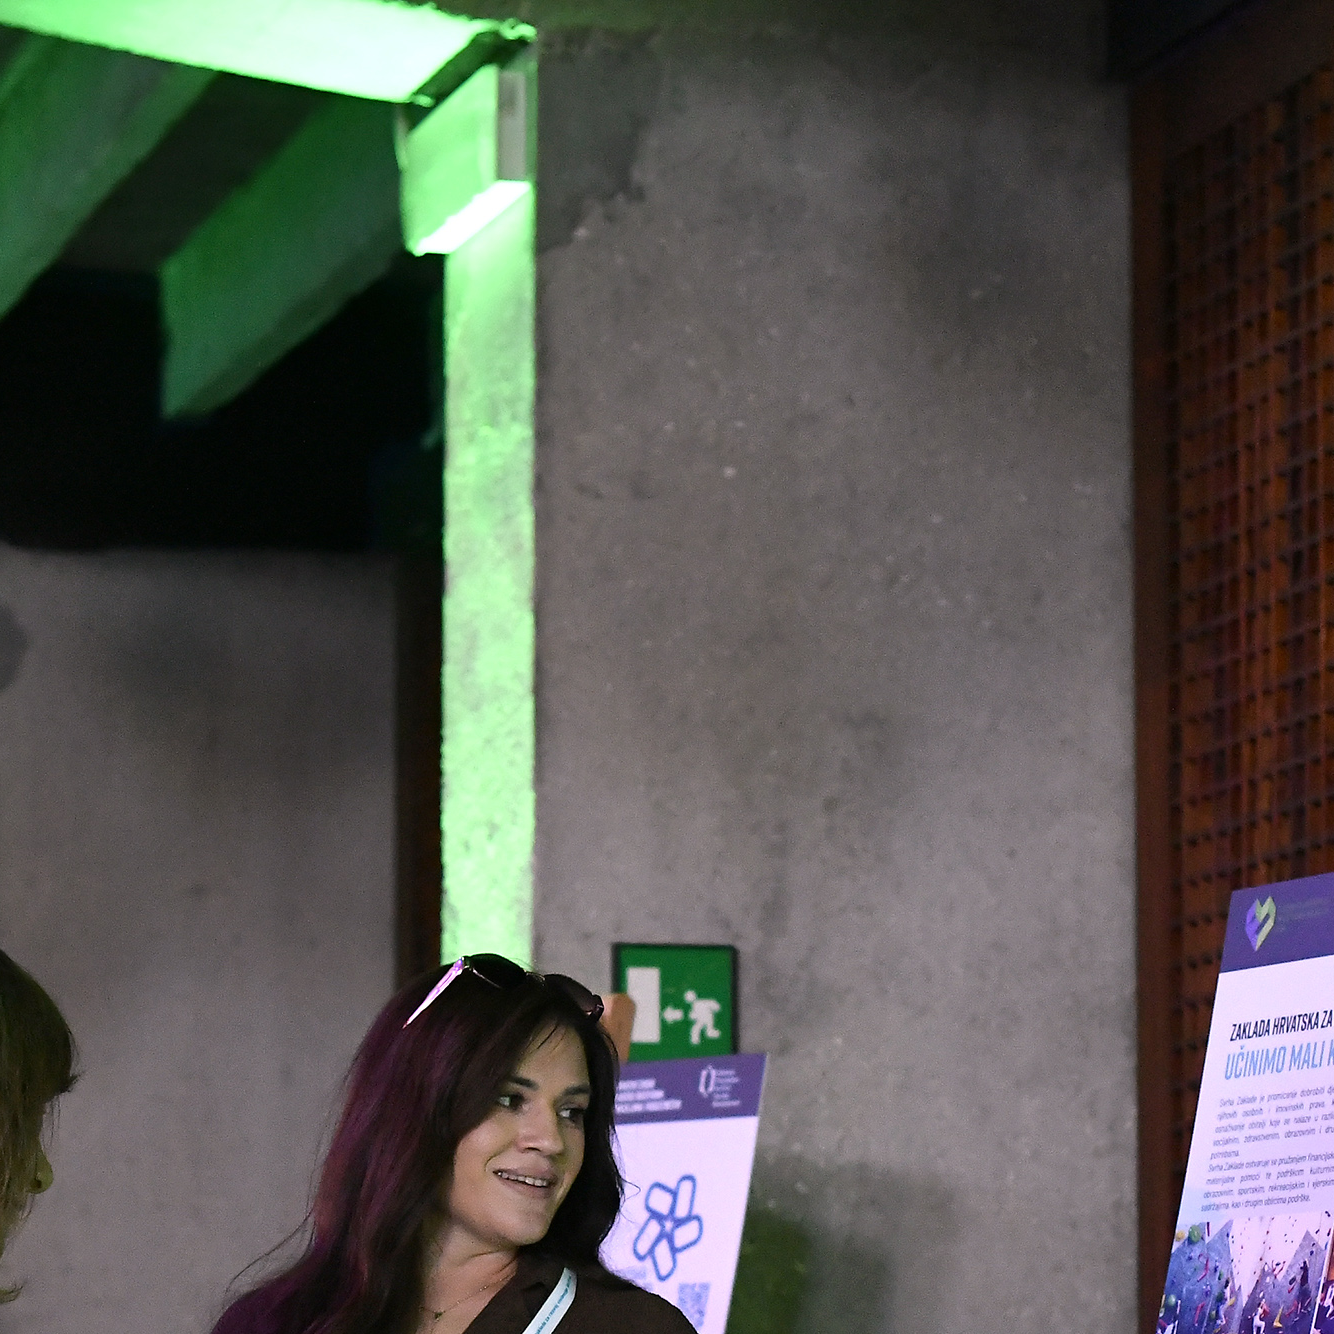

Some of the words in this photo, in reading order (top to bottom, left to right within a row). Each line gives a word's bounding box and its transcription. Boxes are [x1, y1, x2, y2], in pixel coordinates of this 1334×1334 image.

[1230, 1019, 1271, 1042] ZAKLADA
[1272, 1012, 1320, 1035] HRVATSKA
[1320, 1009, 1333, 1029] ZA
[1224, 1045, 1287, 1080] UČINIMO
[1288, 1041, 1326, 1071] MALI
